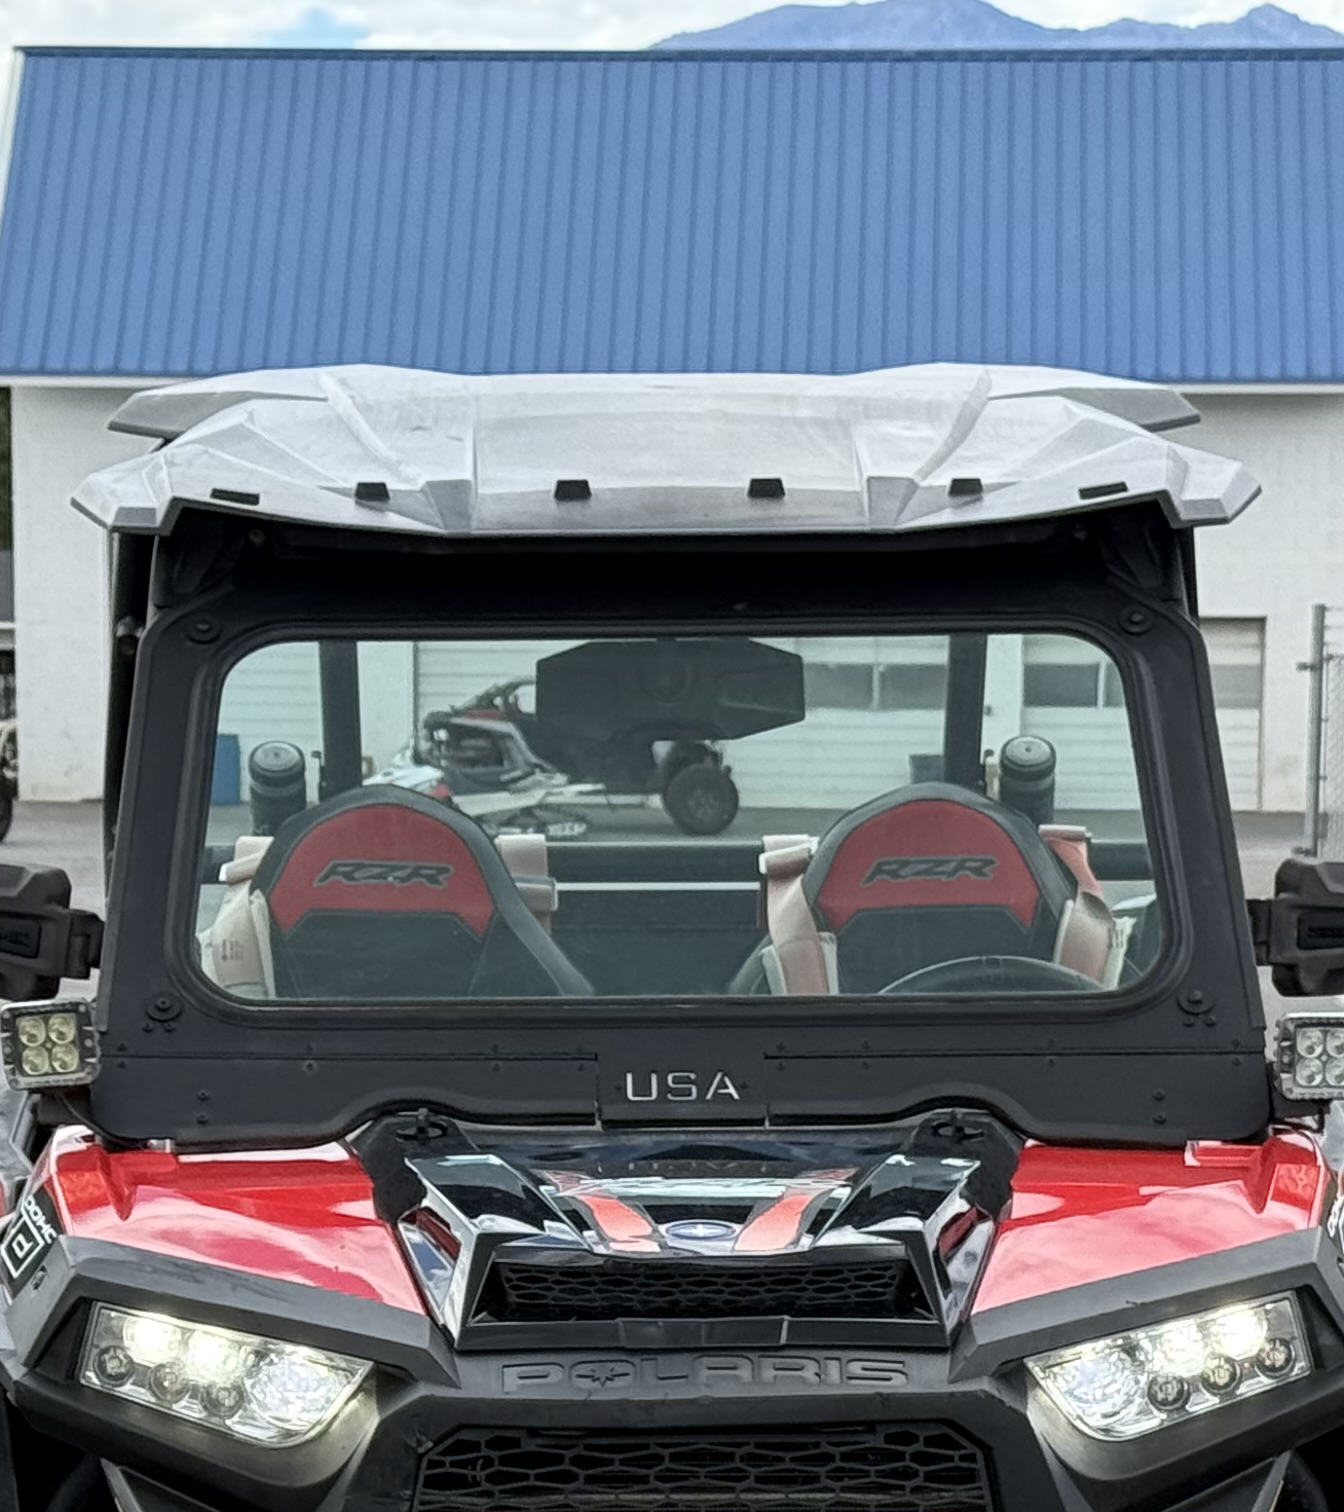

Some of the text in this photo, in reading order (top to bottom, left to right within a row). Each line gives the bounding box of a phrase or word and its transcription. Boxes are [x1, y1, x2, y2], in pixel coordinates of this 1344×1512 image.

[313, 860, 454, 889] RZR
[860, 856, 998, 886] RZR
[625, 1071, 741, 1101] USA
[501, 1354, 908, 1393] POLARIS
